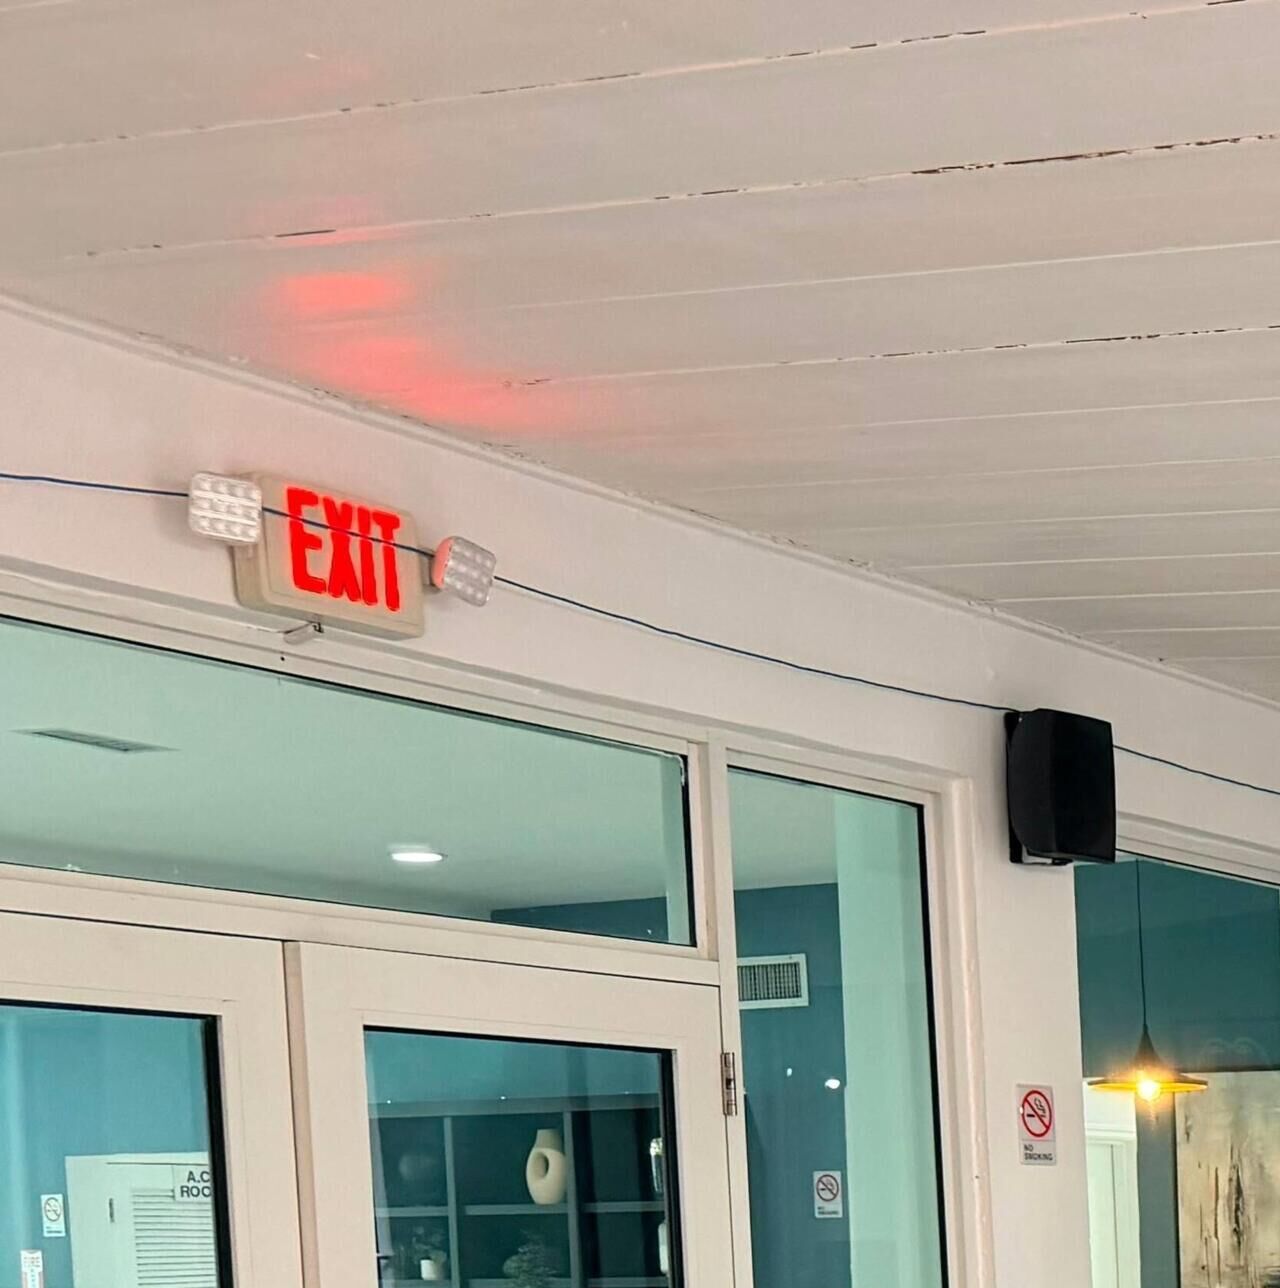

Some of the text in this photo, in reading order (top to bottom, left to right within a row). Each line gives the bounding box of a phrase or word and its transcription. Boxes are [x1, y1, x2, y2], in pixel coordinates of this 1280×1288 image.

[286, 486, 401, 612] EXIT
[1023, 1143, 1034, 1152] NO
[1024, 1152, 1053, 1161] SMOKING
